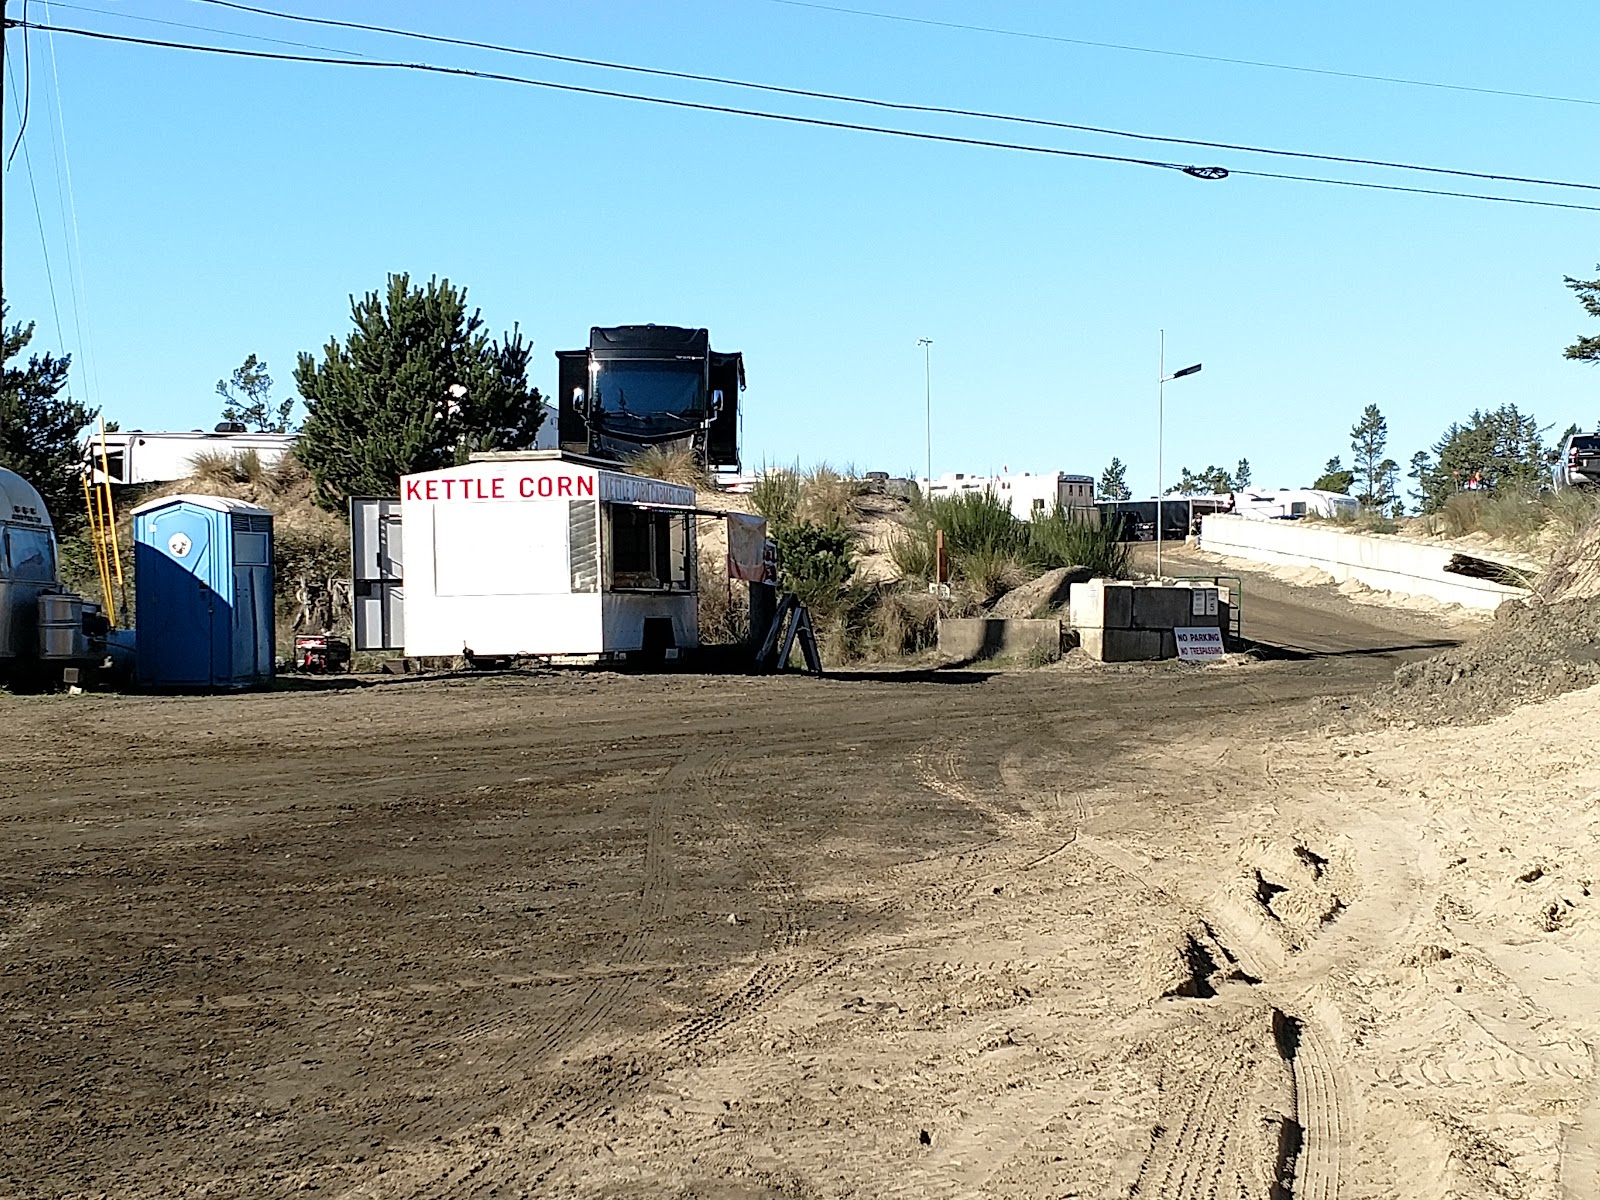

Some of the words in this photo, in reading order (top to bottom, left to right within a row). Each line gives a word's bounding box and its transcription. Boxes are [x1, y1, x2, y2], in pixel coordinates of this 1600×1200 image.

[407, 478, 505, 501] KETTLE
[519, 475, 594, 498] CORN
[1177, 633, 1188, 642] NO
[1190, 633, 1220, 642] PARKING
[1180, 647, 1188, 655] NO
[1189, 646, 1223, 655] TRESPASSING
